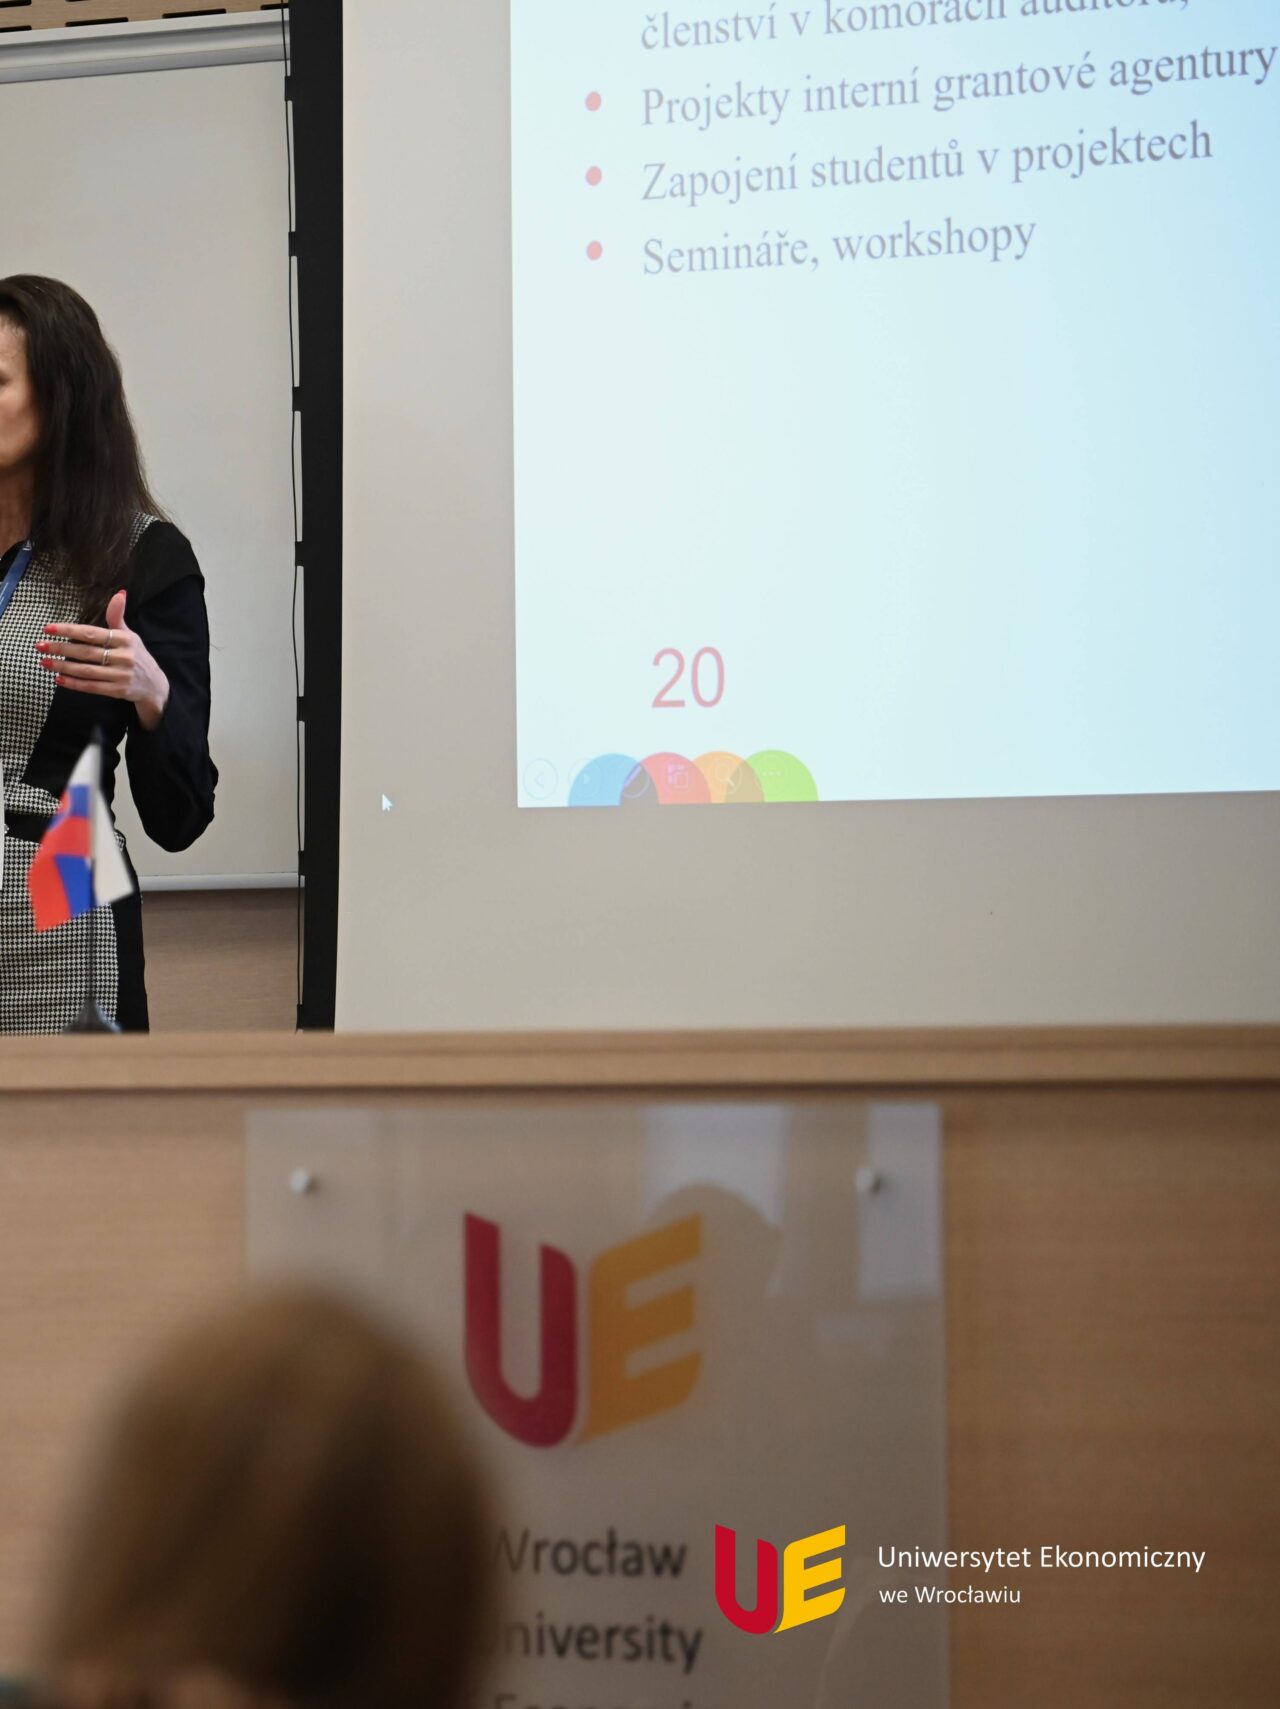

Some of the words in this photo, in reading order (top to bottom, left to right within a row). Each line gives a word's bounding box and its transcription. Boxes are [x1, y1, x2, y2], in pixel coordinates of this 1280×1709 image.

[641, 1, 776, 50] členství
[790, 10, 811, 36] v
[642, 80, 790, 131] Projekty
[803, 66, 920, 112] interní
[933, 51, 1096, 111] grantové
[1109, 45, 1278, 95] agentury
[642, 153, 798, 207] Zapojení
[811, 139, 964, 188] studentů
[977, 148, 1000, 174] v
[1011, 118, 1213, 184] projektech
[643, 229, 819, 274] Semináře,
[832, 215, 1036, 263] workshopy
[651, 646, 725, 708] 20
[464, 1211, 702, 1449] UE
[504, 1611, 703, 1675] niversity
